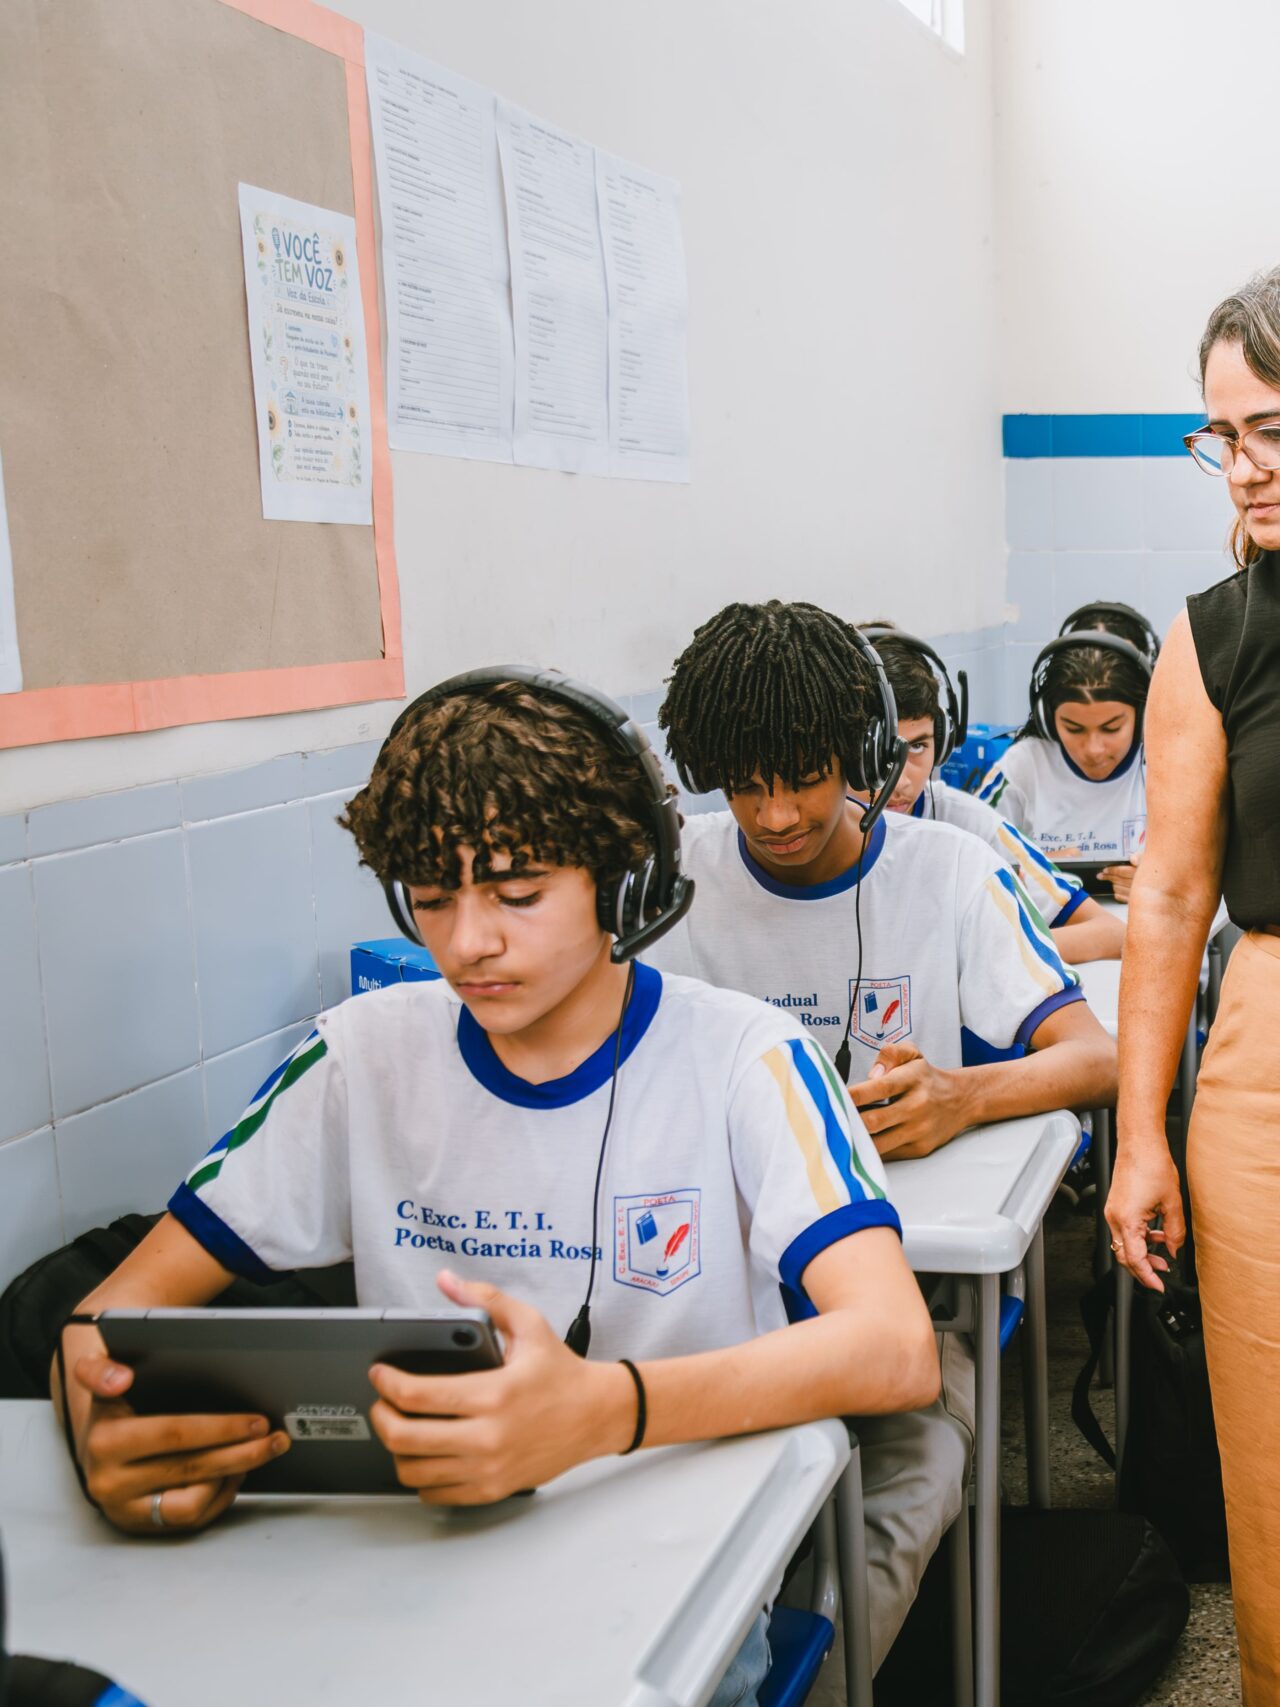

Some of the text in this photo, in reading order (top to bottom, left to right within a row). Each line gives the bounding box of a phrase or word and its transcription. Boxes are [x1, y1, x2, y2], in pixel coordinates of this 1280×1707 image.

[282, 232, 322, 265] VOCÊ
[275, 259, 333, 292] TEM VOZ
[1093, 842, 1118, 851] Rosa
[358, 975, 382, 992] Multi
[763, 993, 818, 1008] tadual
[800, 1012, 841, 1026] Rosa
[644, 1196, 676, 1207] POETA
[397, 1200, 553, 1231] C. Exc. E. T. I.
[394, 1228, 603, 1261] Poeta Garcia Rosa
